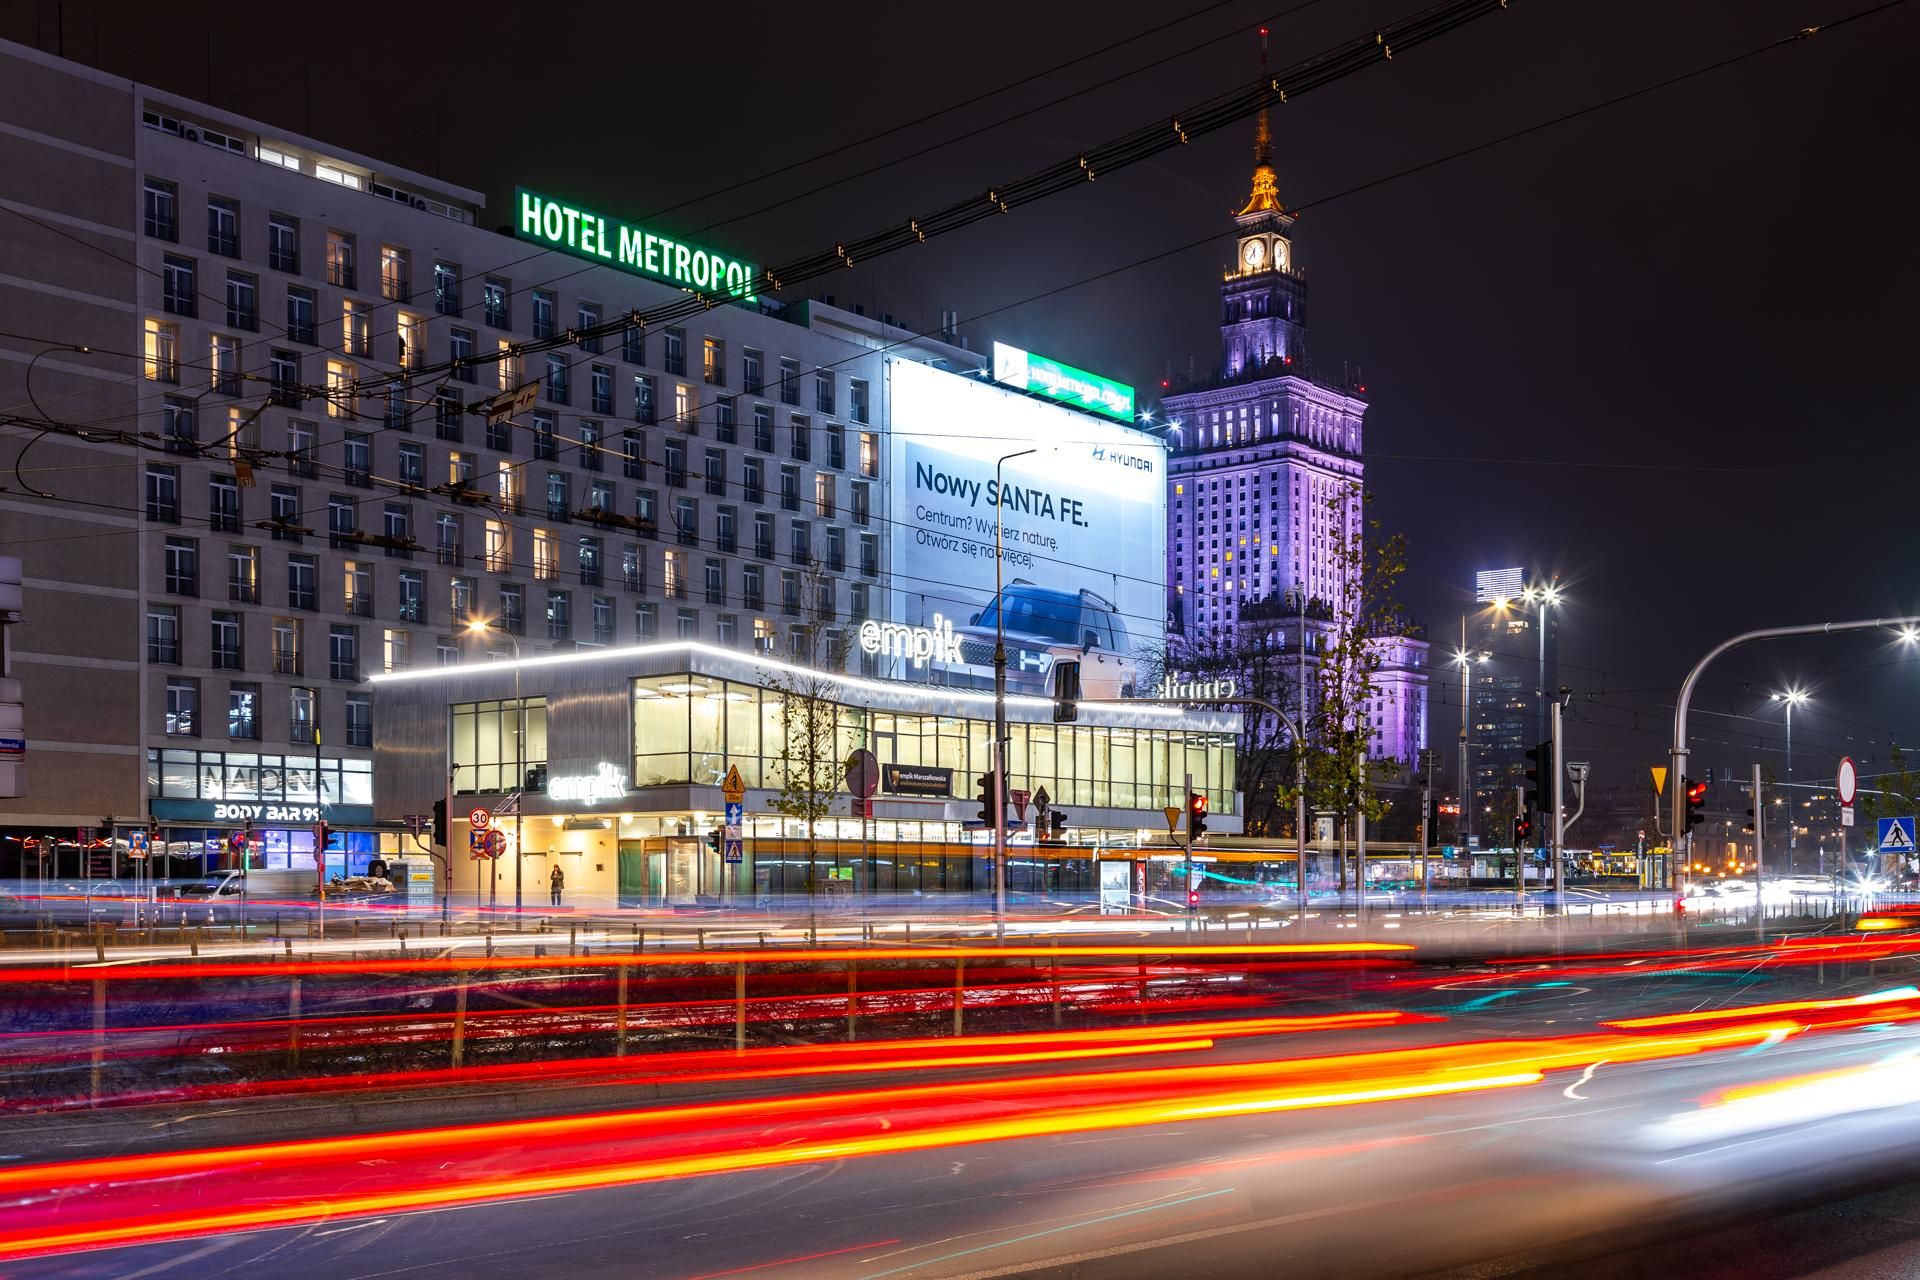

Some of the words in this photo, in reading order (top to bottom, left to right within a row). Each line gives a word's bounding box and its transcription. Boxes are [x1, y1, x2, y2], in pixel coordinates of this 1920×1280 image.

[522, 192, 612, 259] HOTEL
[618, 225, 758, 304] METROPOL
[1110, 451, 1153, 473] HYUNDAI
[916, 461, 981, 507] Nowy
[986, 479, 1056, 521] SANTA
[1060, 497, 1089, 528] FE.
[916, 505, 973, 530] Centrum?
[975, 517, 1020, 541] Wybierz
[1022, 528, 1059, 553] naturę.
[916, 529, 958, 552] Otwórz
[961, 540, 977, 560] się
[980, 545, 995, 559] na
[860, 613, 964, 668] empik
[549, 762, 628, 806] empik
[214, 804, 263, 820] BODY
[266, 805, 301, 821] BAR
[302, 807, 323, 821] 99
[473, 813, 487, 823] 30
